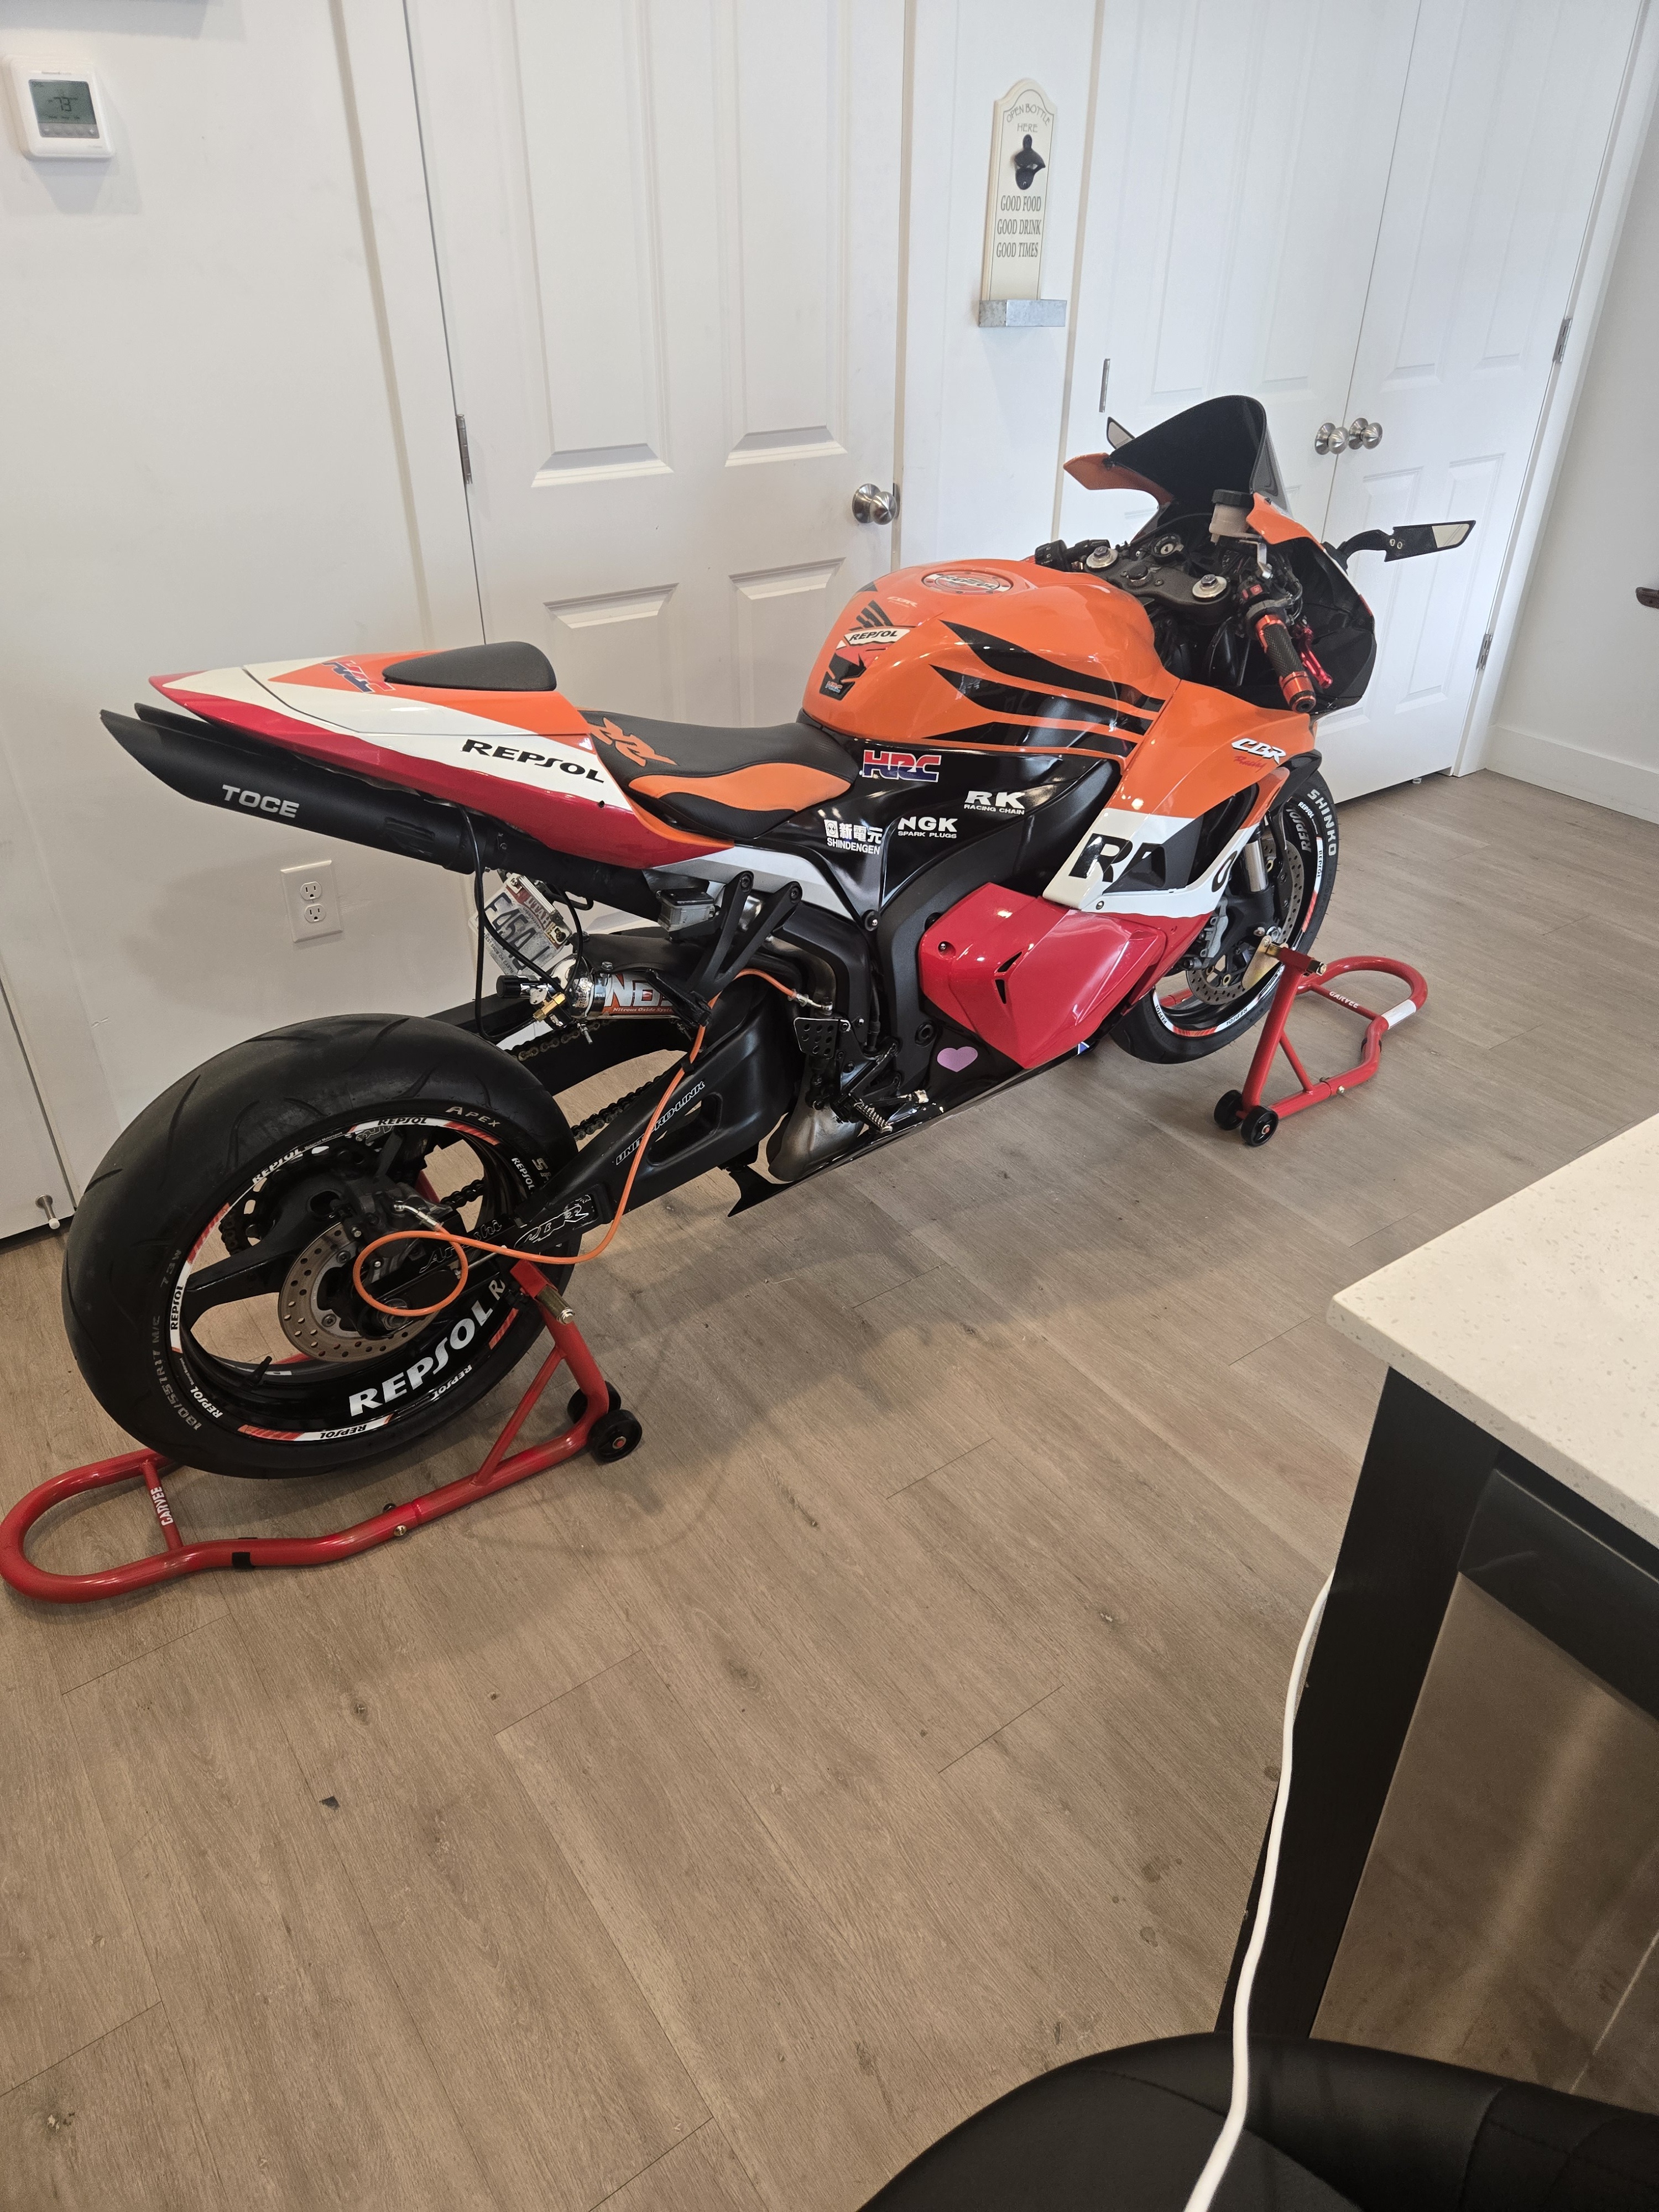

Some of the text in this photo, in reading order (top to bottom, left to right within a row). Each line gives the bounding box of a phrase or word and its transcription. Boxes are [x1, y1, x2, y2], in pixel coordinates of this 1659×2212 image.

[1006, 103, 1050, 127] OPEN BOTTLE
[1017, 123, 1038, 133] HERE
[1000, 195, 1041, 212] GOOD FOOD
[997, 218, 1042, 235] GOOD DRINK
[996, 242, 1039, 258] GOOD TIMES
[849, 630, 898, 642] REPSOL
[461, 739, 605, 784] REPSOL
[1231, 738, 1286, 765] CBR
[862, 749, 942, 782] HRC
[222, 784, 300, 818] TOCE
[964, 790, 1026, 810] RK
[964, 804, 997, 812] RACING
[1298, 801, 1315, 819] REPSOL
[897, 816, 958, 832] NGK
[1307, 789, 1337, 856] SHINKO
[839, 823, 883, 844] 新電元
[827, 837, 880, 855] SHINDENGEN
[524, 896, 551, 931] UTAH
[1329, 991, 1359, 1009] GARVEE
[378, 1117, 427, 1126] REPSOL
[252, 1148, 302, 1184] REPSOL
[512, 1157, 535, 1190] REPSOL
[170, 1285, 184, 1331] REPSOL
[348, 1300, 494, 1417] REPSOL
[429, 1364, 473, 1401] REPSOL
[190, 1386, 223, 1418] REPSOL
[320, 1424, 367, 1439] REPSOL
